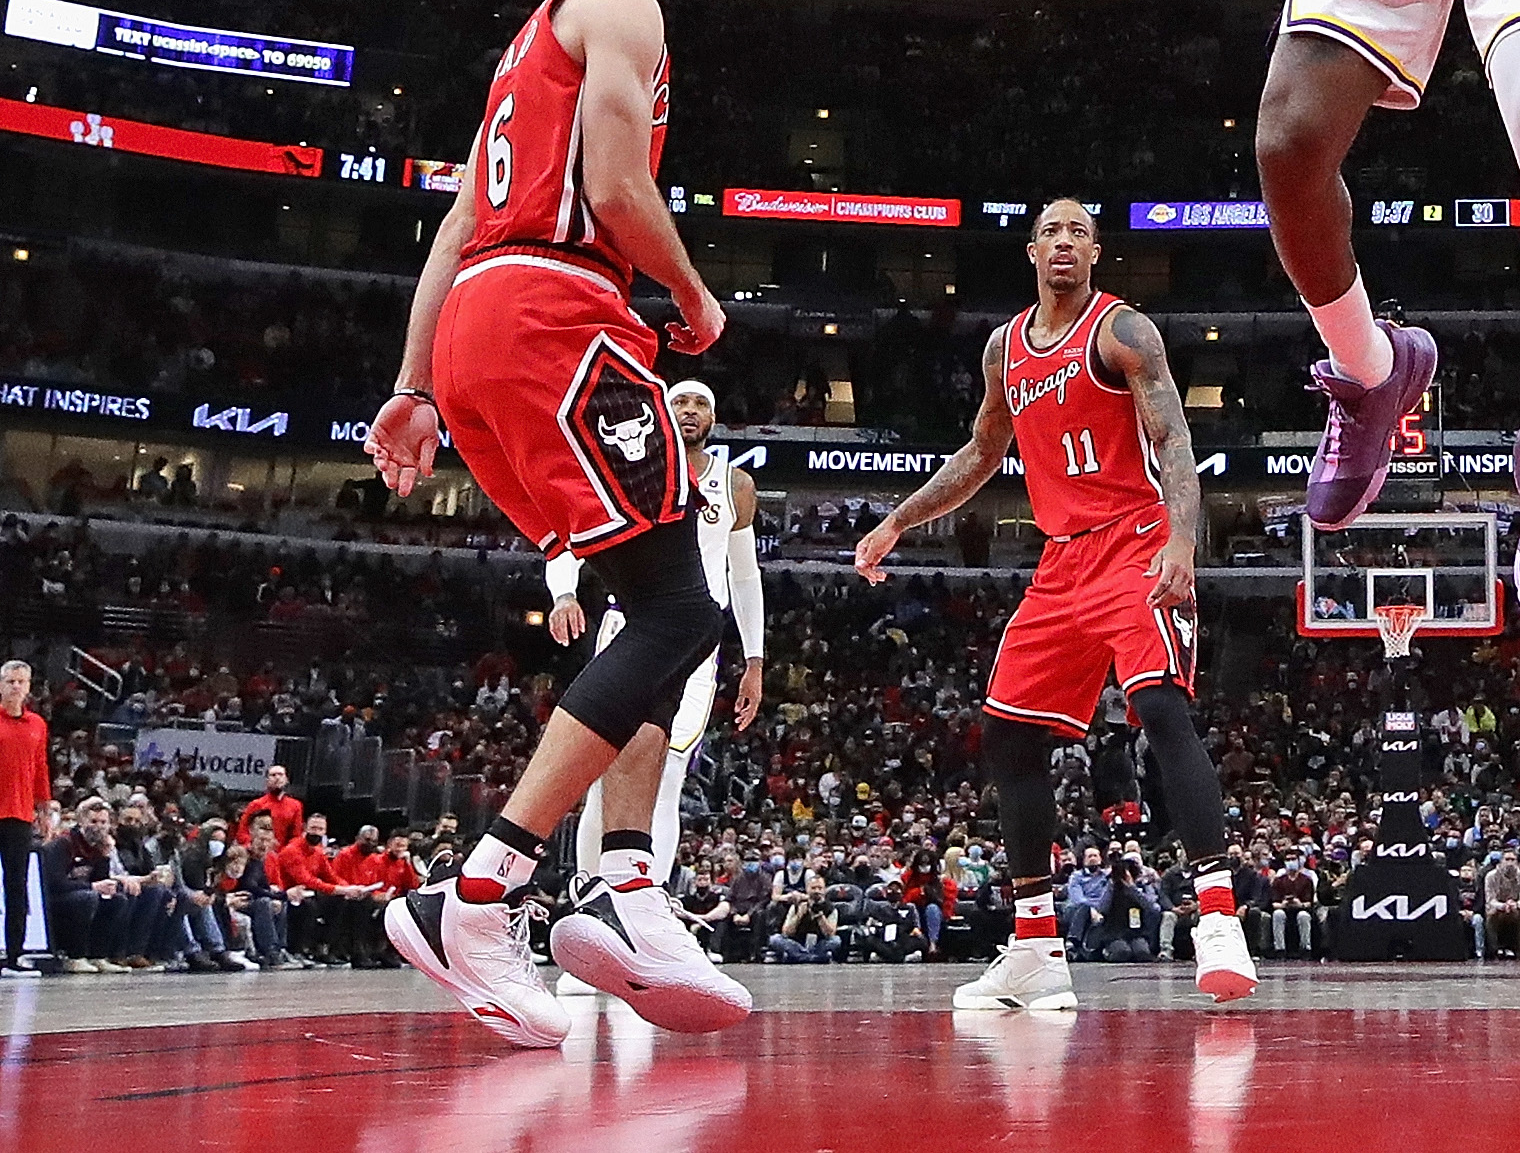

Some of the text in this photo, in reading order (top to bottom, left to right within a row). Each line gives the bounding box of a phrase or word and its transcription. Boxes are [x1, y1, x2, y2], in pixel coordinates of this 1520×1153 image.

[114, 27, 152, 47] TEXT
[262, 50, 285, 65] TO
[287, 53, 331, 70] 69050
[486, 92, 515, 210] 6
[340, 153, 386, 182] 7:41
[836, 202, 913, 219] CHAMPIONS
[913, 206, 947, 220] CLUB
[1182, 204, 1211, 226] LOS
[1371, 200, 1414, 224] 9:37
[1429, 205, 1436, 219] 2
[1471, 202, 1494, 223] 30
[1008, 360, 1082, 416] Chicago
[44, 388, 151, 420] INSPIRES
[193, 403, 289, 437] KIA
[808, 450, 933, 473] MOVEMENT
[1061, 428, 1100, 477] 11
[1459, 453, 1514, 473] INSPI
[1382, 740, 1418, 751] KIA
[1382, 790, 1419, 802] KIA
[1376, 842, 1427, 858] KIA
[1352, 893, 1448, 921] KIA
